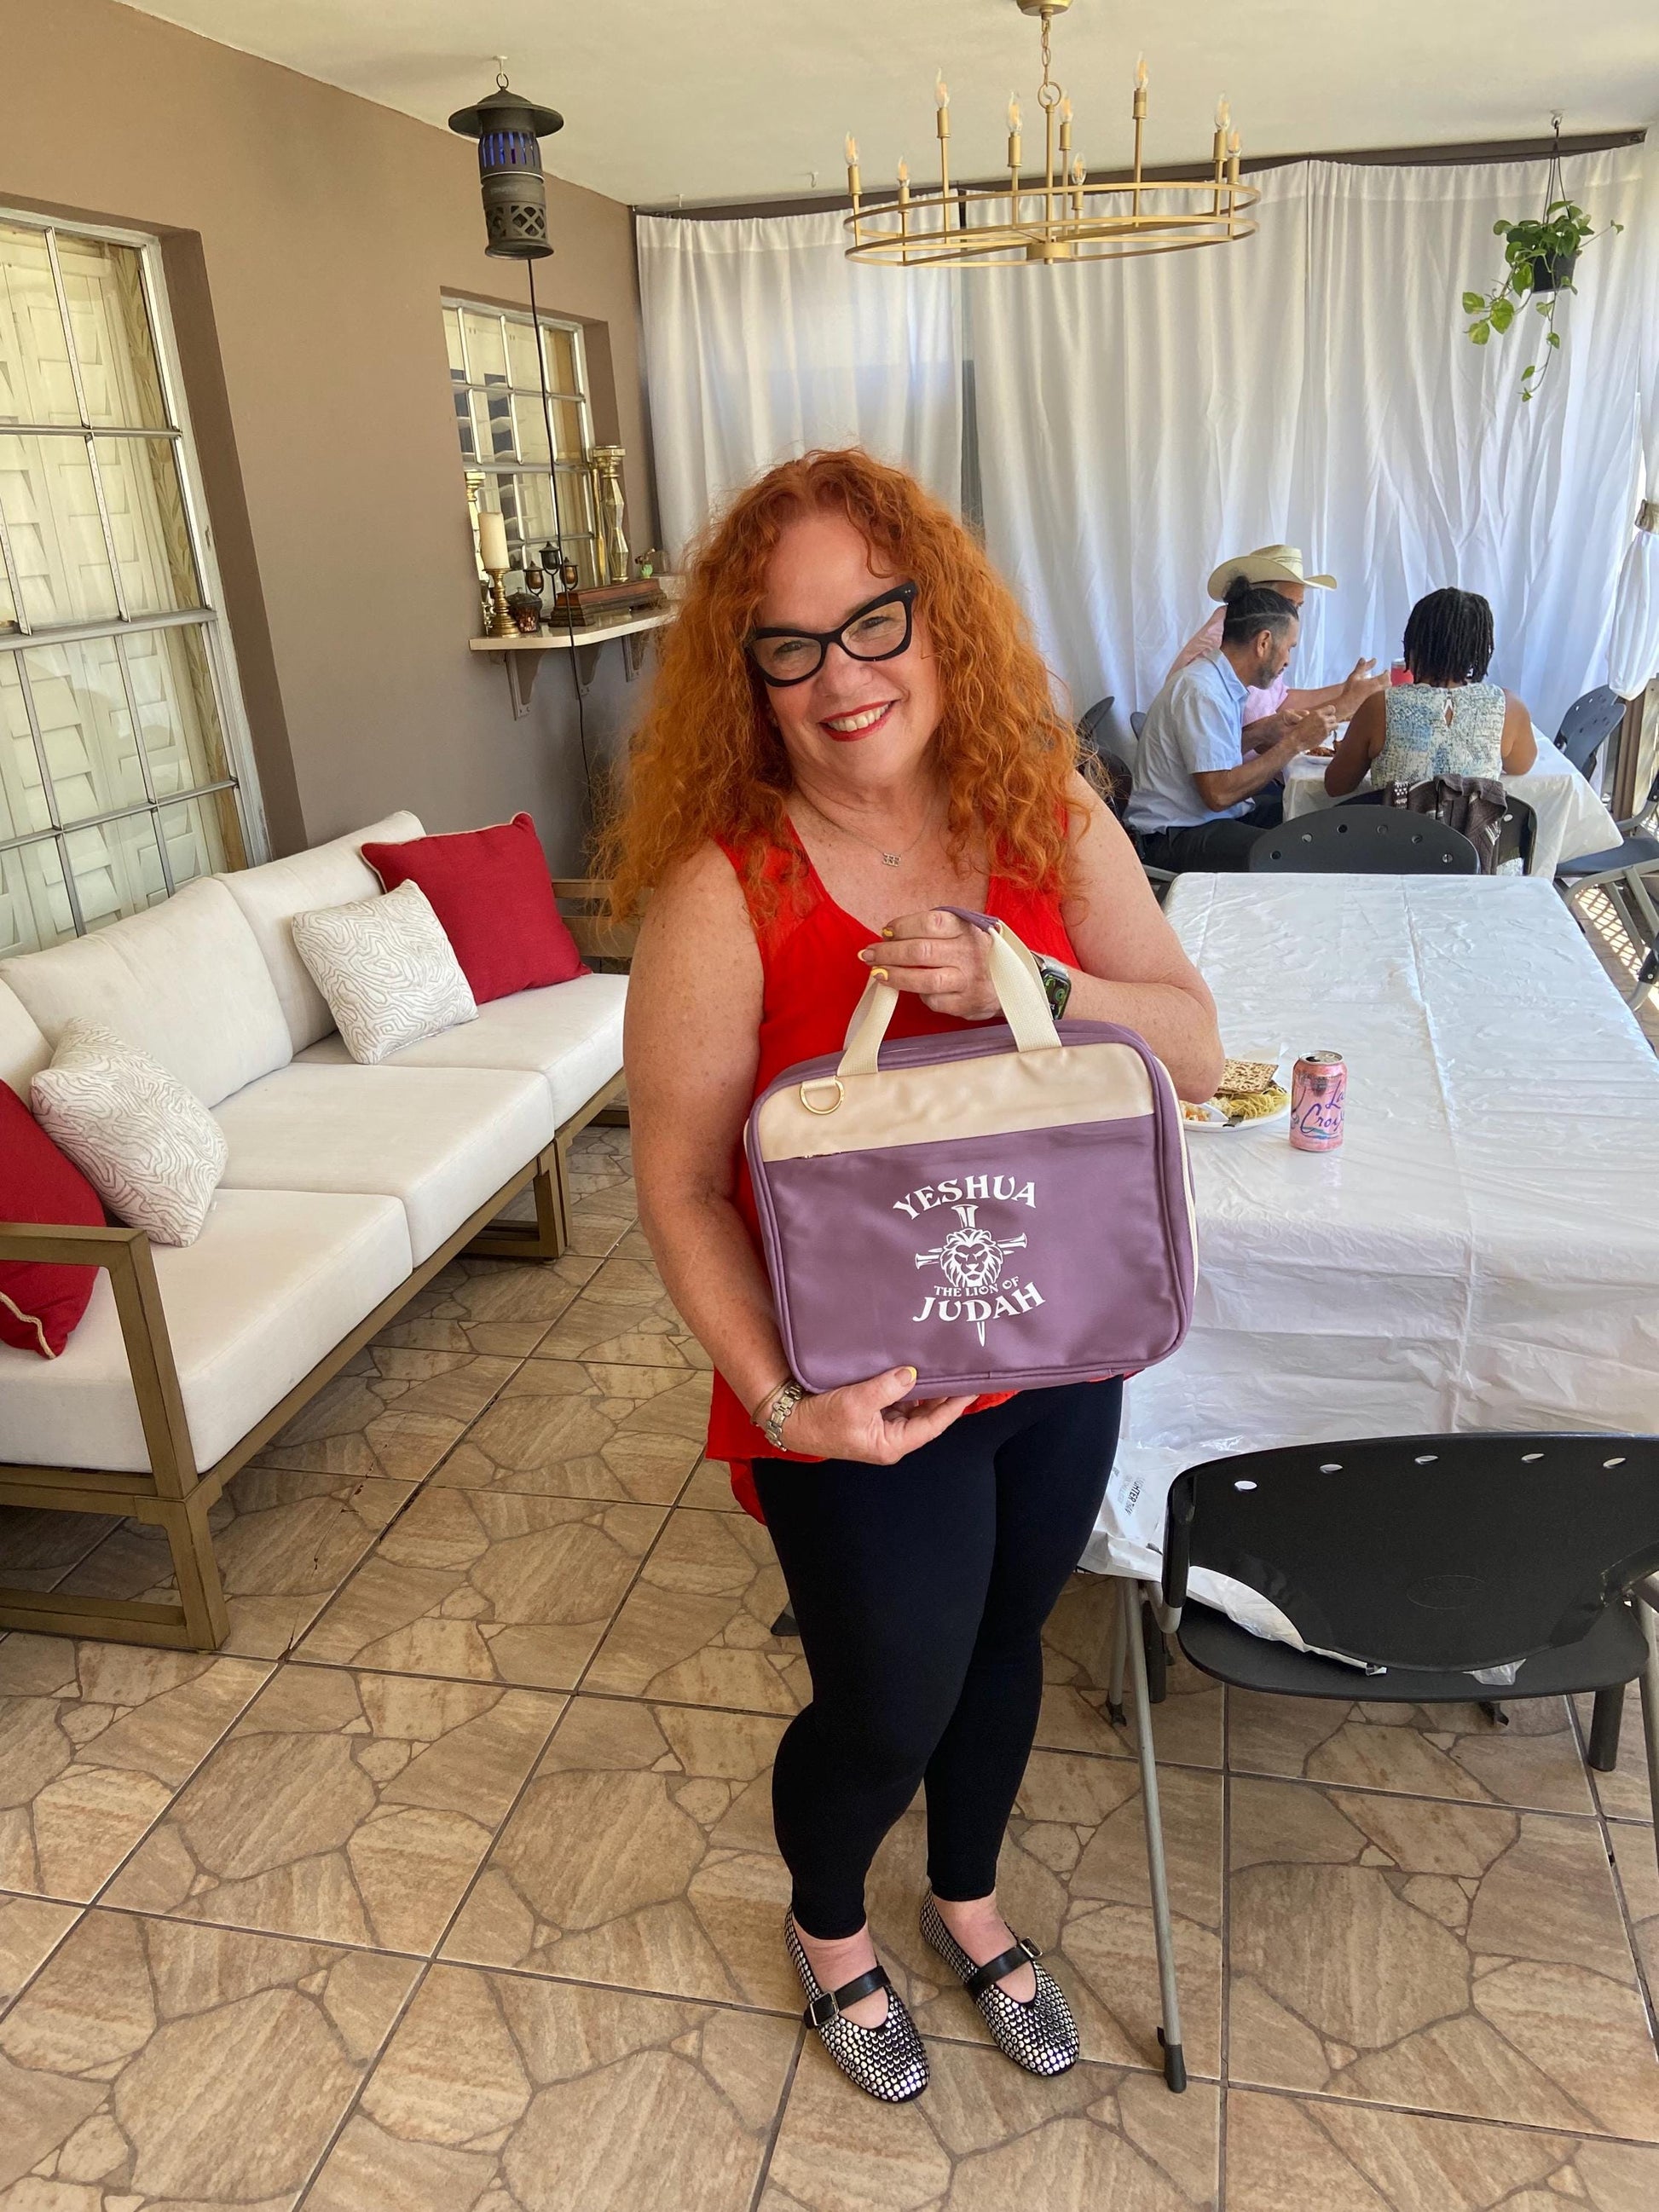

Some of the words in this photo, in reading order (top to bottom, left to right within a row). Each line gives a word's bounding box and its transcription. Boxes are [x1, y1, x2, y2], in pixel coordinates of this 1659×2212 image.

[893, 1175, 1037, 1220] YESHUA
[912, 1281, 1046, 1322] JUDAH
[934, 1285, 962, 1297] THE
[966, 1283, 999, 1297] LION
[1002, 1275, 1019, 1290] OF
